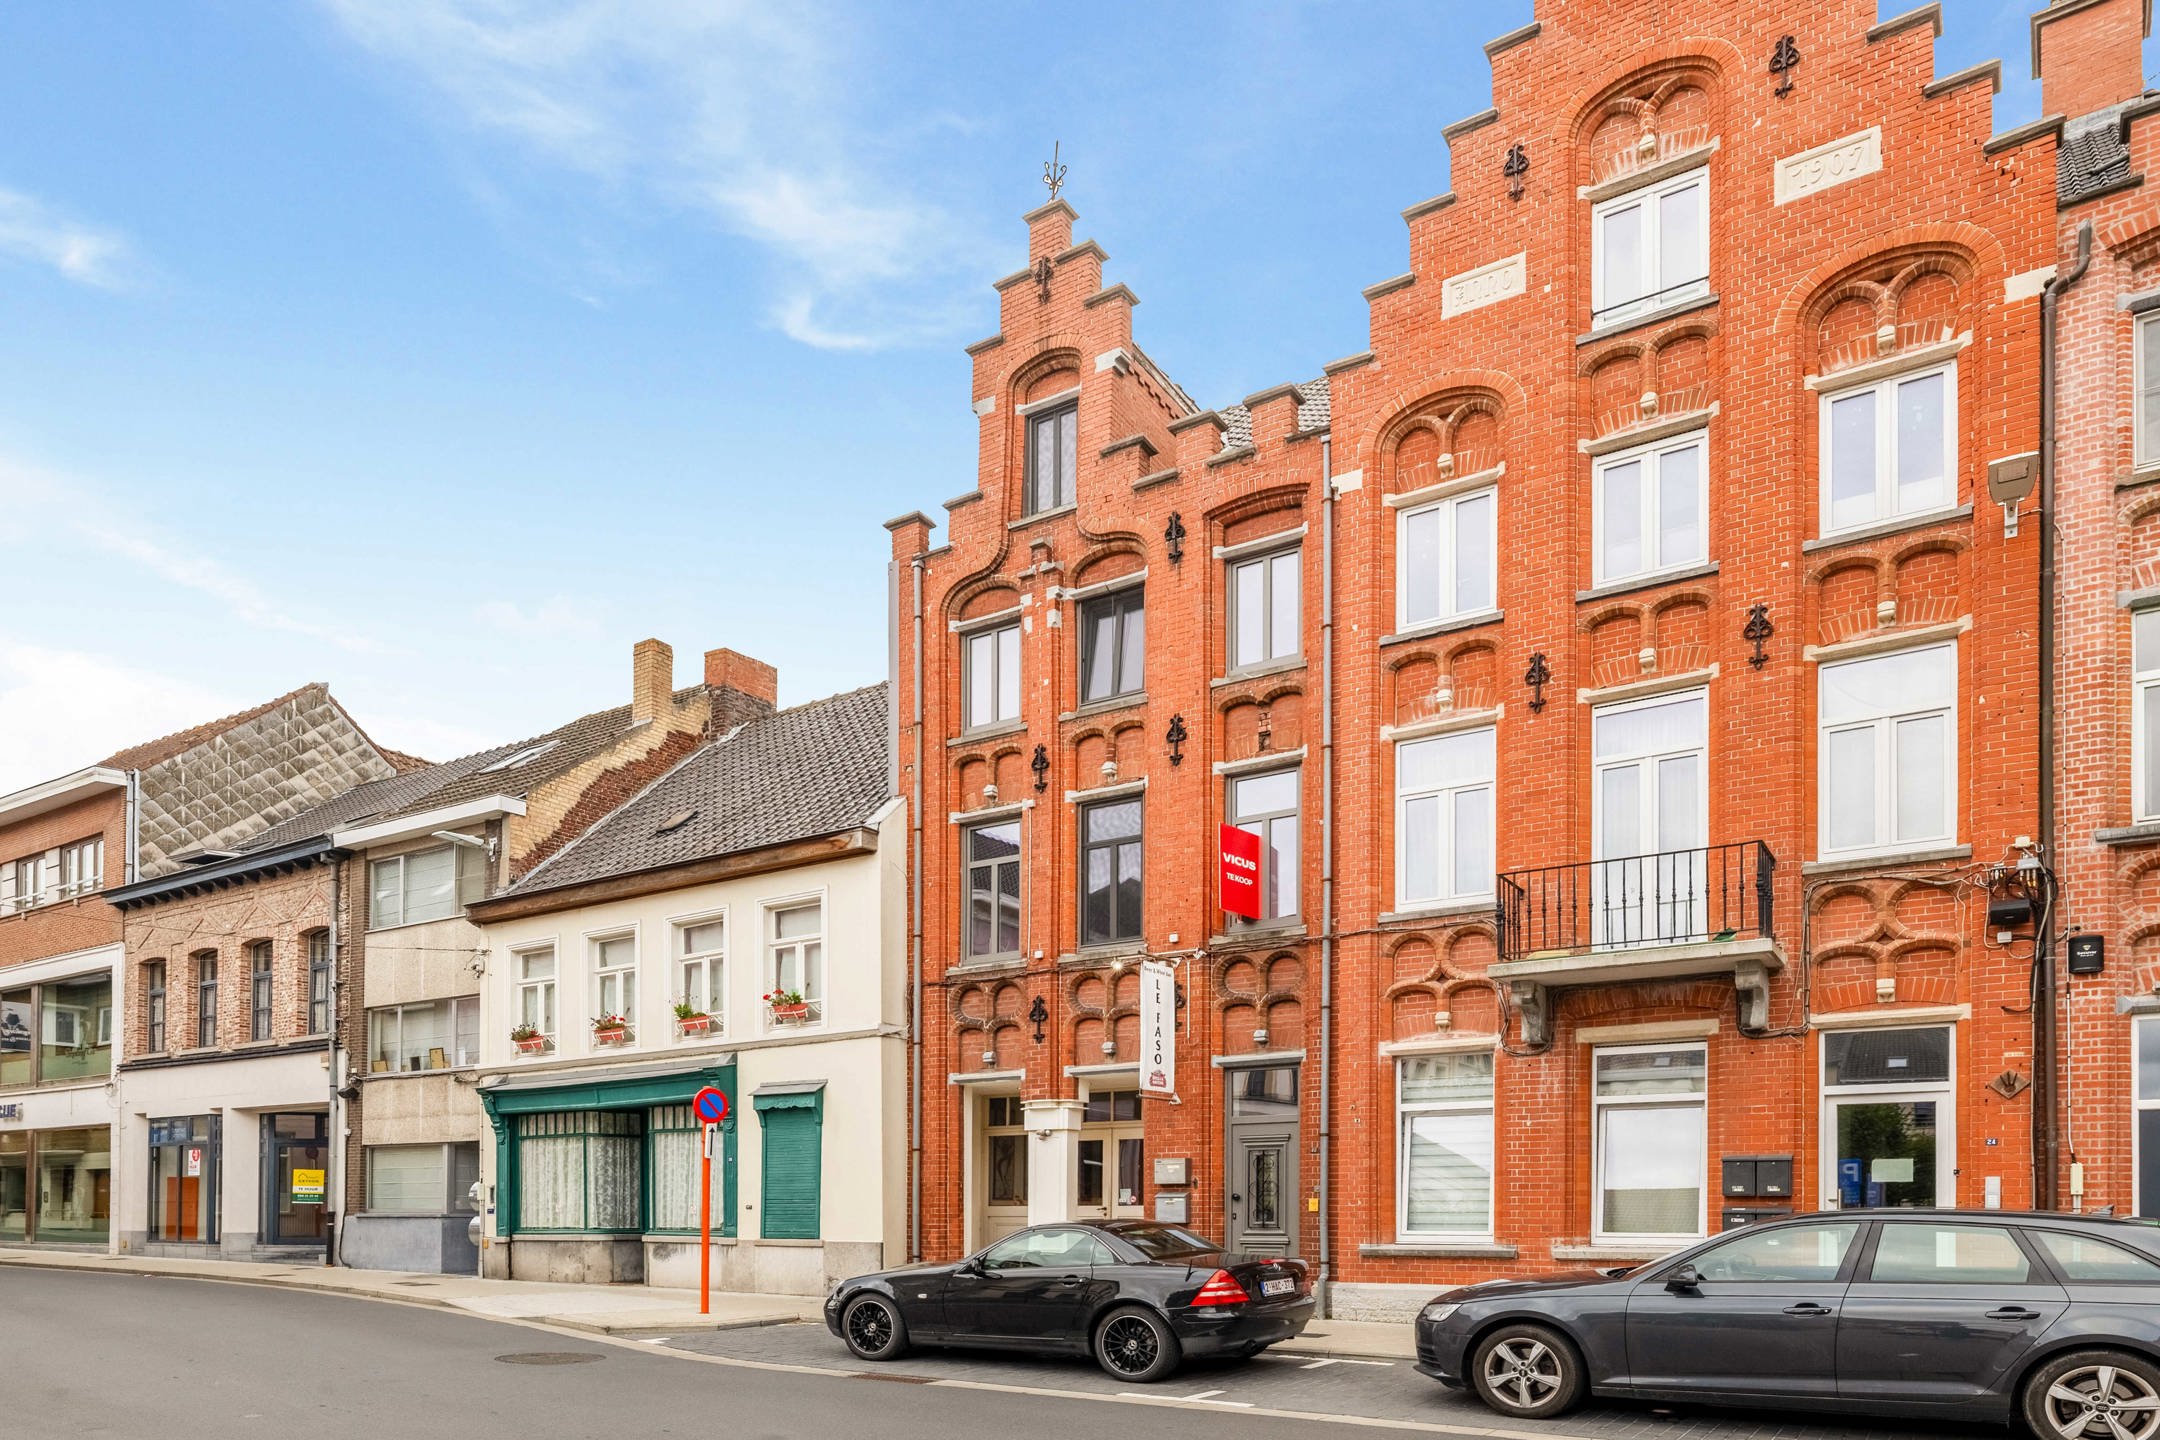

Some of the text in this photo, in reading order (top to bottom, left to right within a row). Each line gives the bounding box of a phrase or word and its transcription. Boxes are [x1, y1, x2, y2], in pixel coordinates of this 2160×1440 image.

[1791, 146, 1864, 189] 1907
[1222, 852, 1256, 871] VICUS
[1226, 872, 1253, 886] TE KOOP
[1154, 979, 1162, 1065] LE FASO
